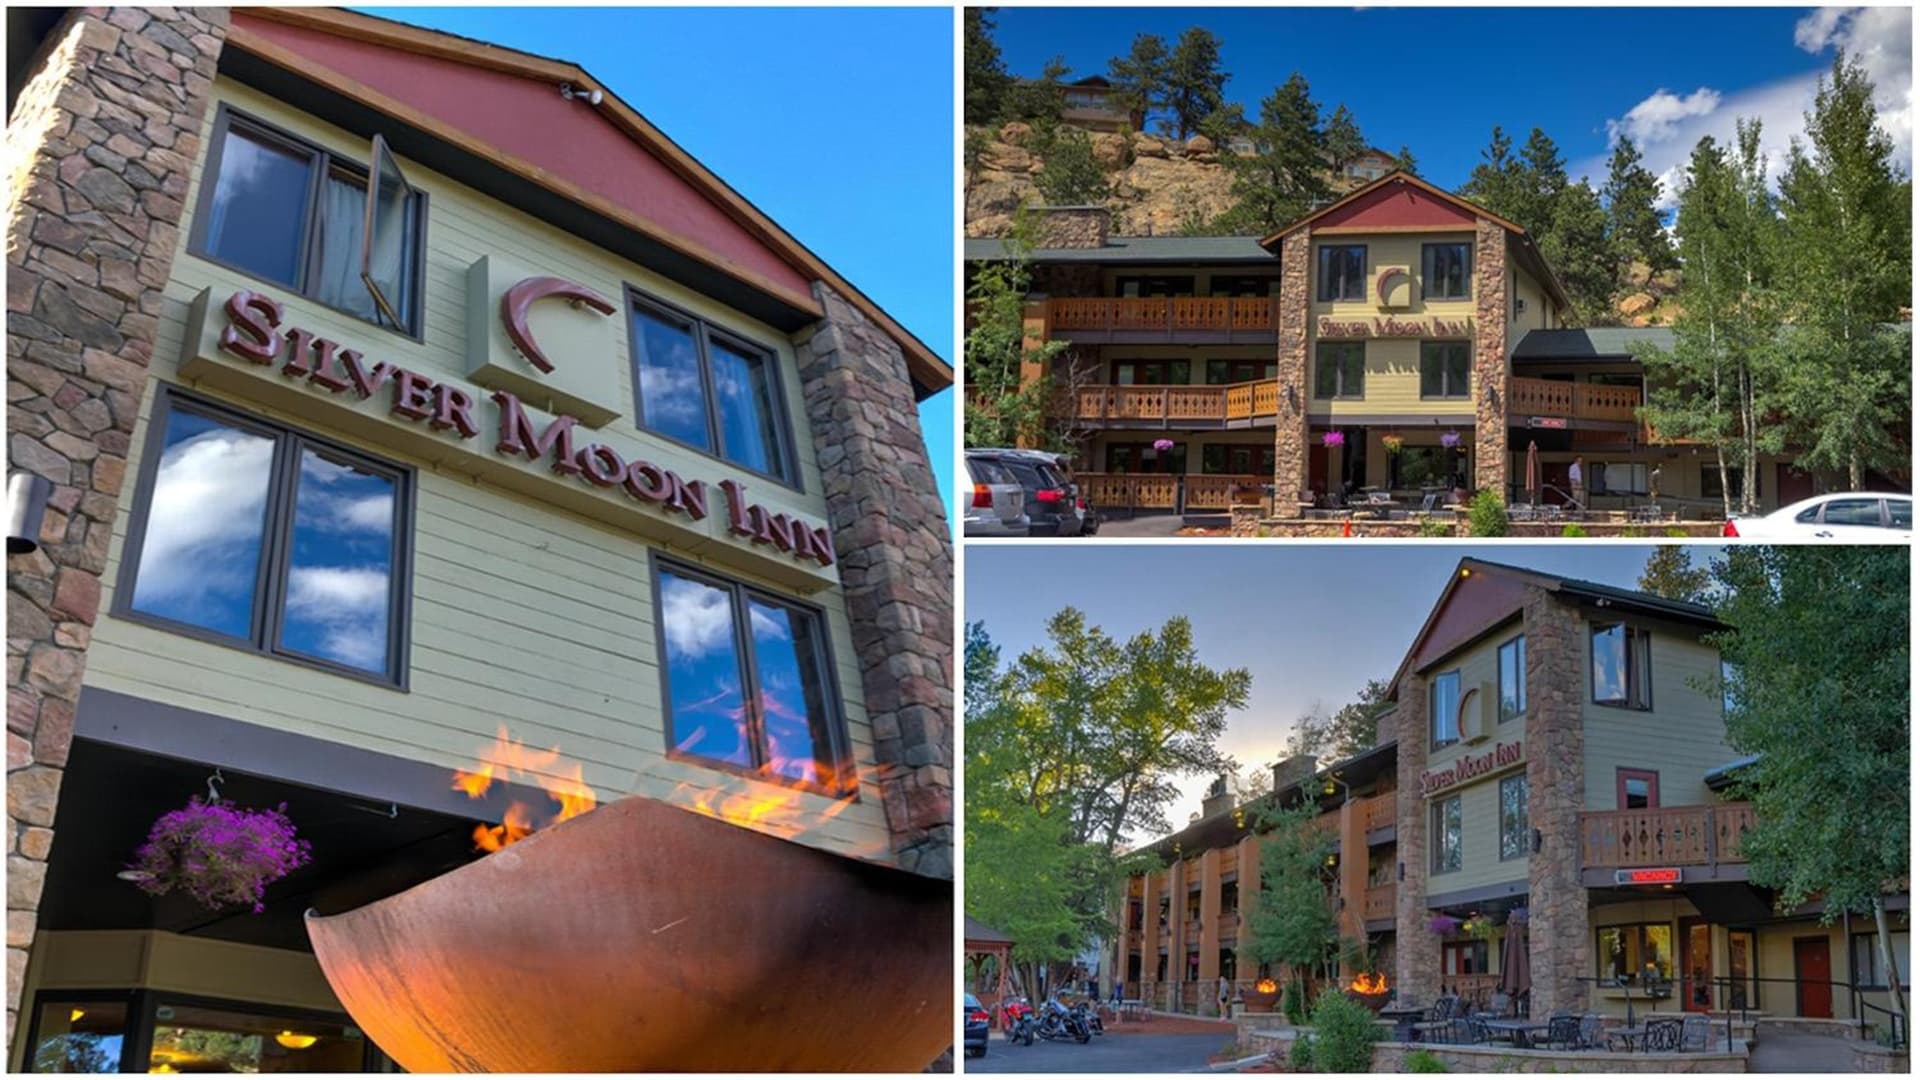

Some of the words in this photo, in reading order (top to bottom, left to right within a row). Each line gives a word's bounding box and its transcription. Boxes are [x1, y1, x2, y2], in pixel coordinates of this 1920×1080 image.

[1319, 317, 1369, 336] SILVER
[1375, 317, 1426, 336] MOON
[1433, 316, 1470, 336] INN
[219, 288, 480, 439] SILVER
[491, 391, 707, 520] MOON
[718, 478, 834, 565] INN
[1421, 770, 1455, 793] SILVER
[1456, 752, 1493, 780] MOON
[1496, 741, 1521, 766] INN
